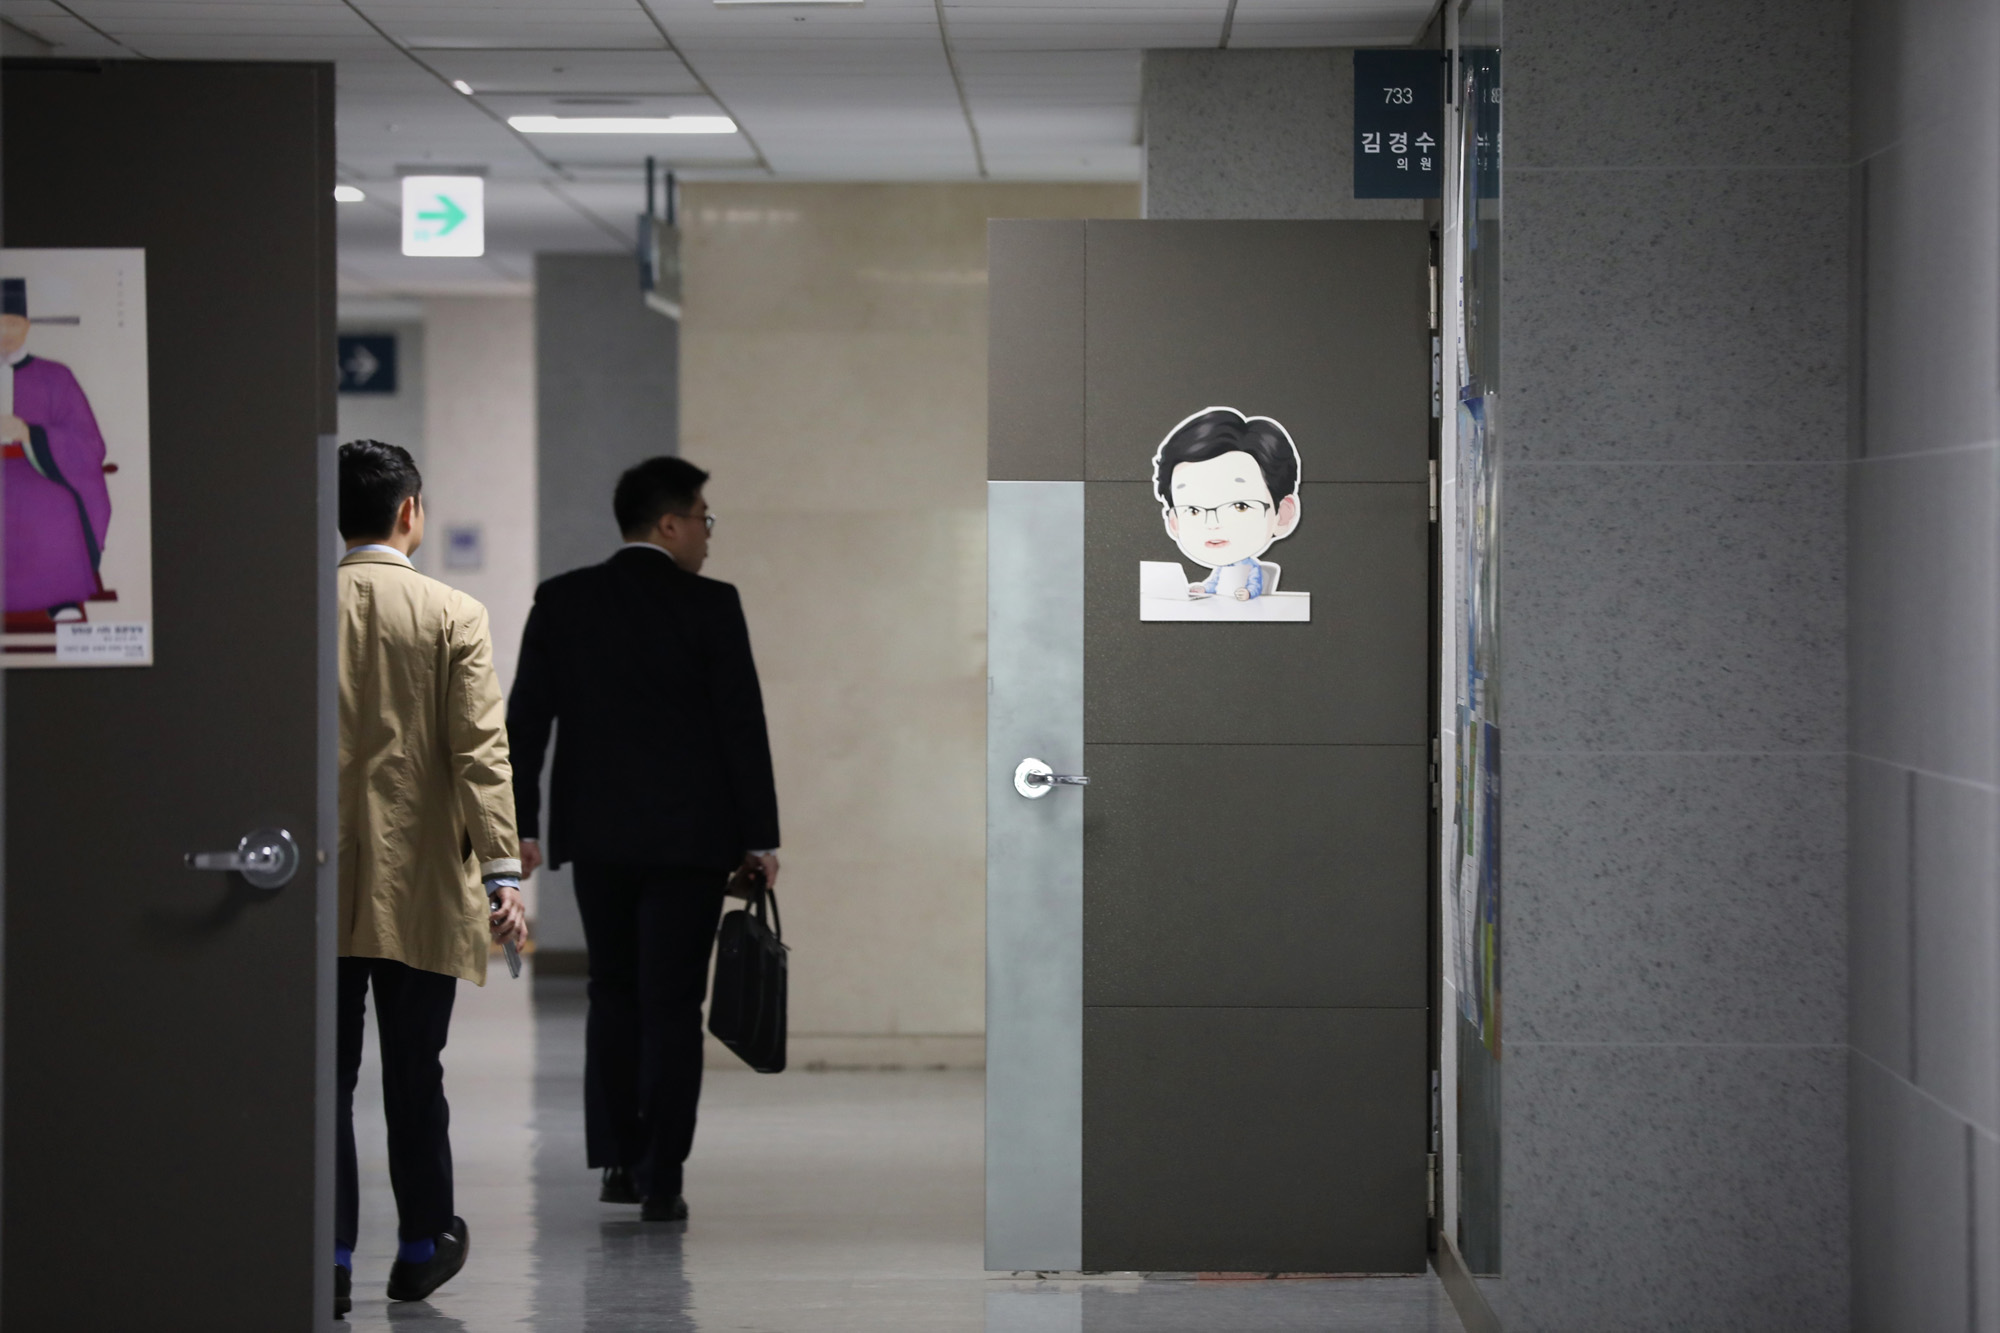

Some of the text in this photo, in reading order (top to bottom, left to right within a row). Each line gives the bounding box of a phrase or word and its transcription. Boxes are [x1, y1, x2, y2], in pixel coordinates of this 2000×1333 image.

[1383, 87, 1413, 105] 733
[1361, 131, 1436, 154] 김경수
[1396, 156, 1432, 172] 의원
